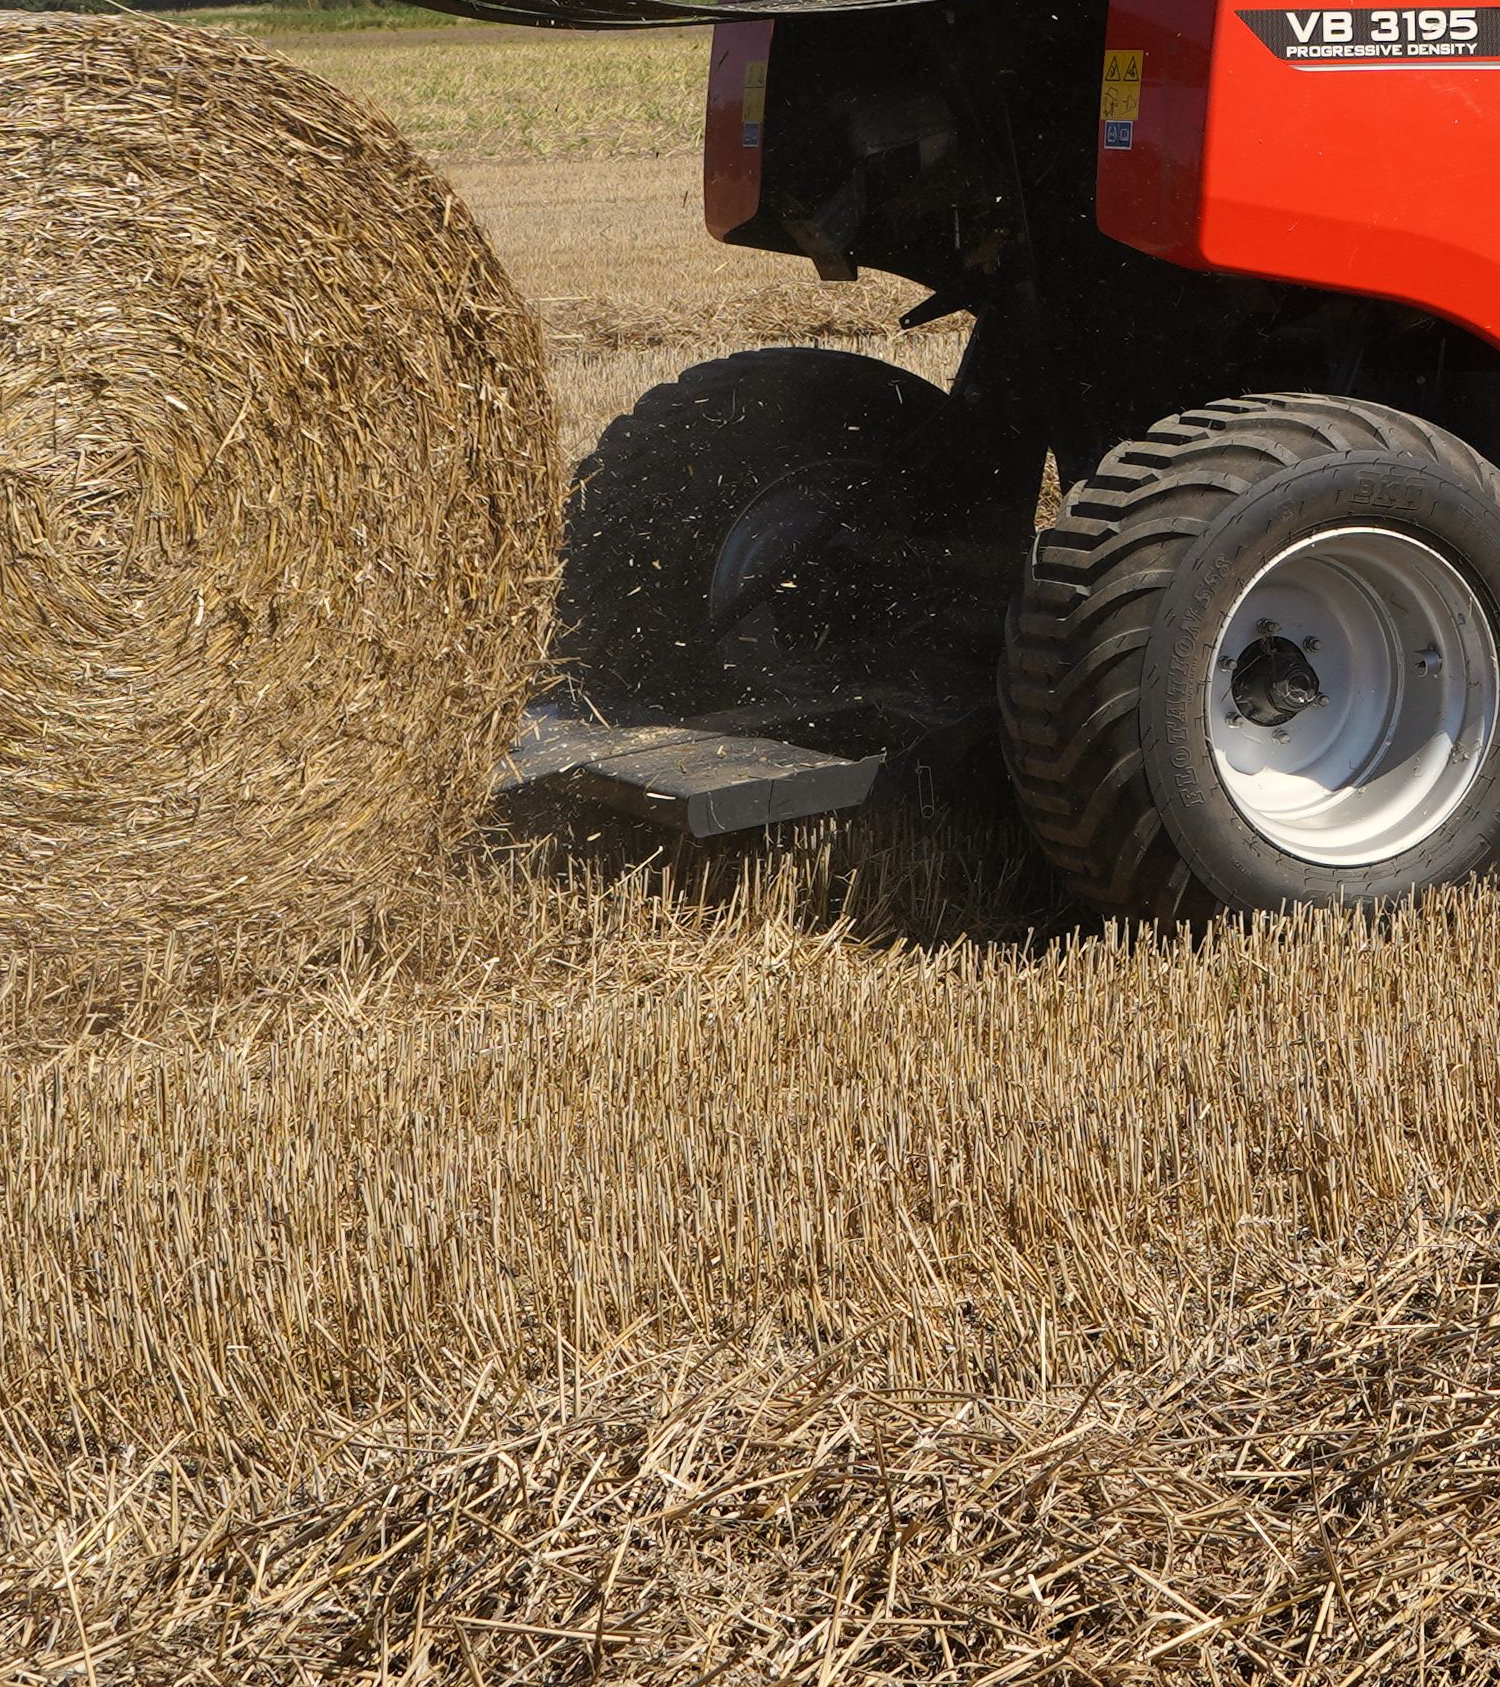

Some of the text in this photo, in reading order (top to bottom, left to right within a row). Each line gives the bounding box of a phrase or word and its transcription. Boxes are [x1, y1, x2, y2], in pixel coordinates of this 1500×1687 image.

[1285, 9, 1479, 43] VB 3195
[1286, 43, 1479, 58] PROGRESSIVE DENSITY
[1165, 606, 1205, 809] FLOTATION
